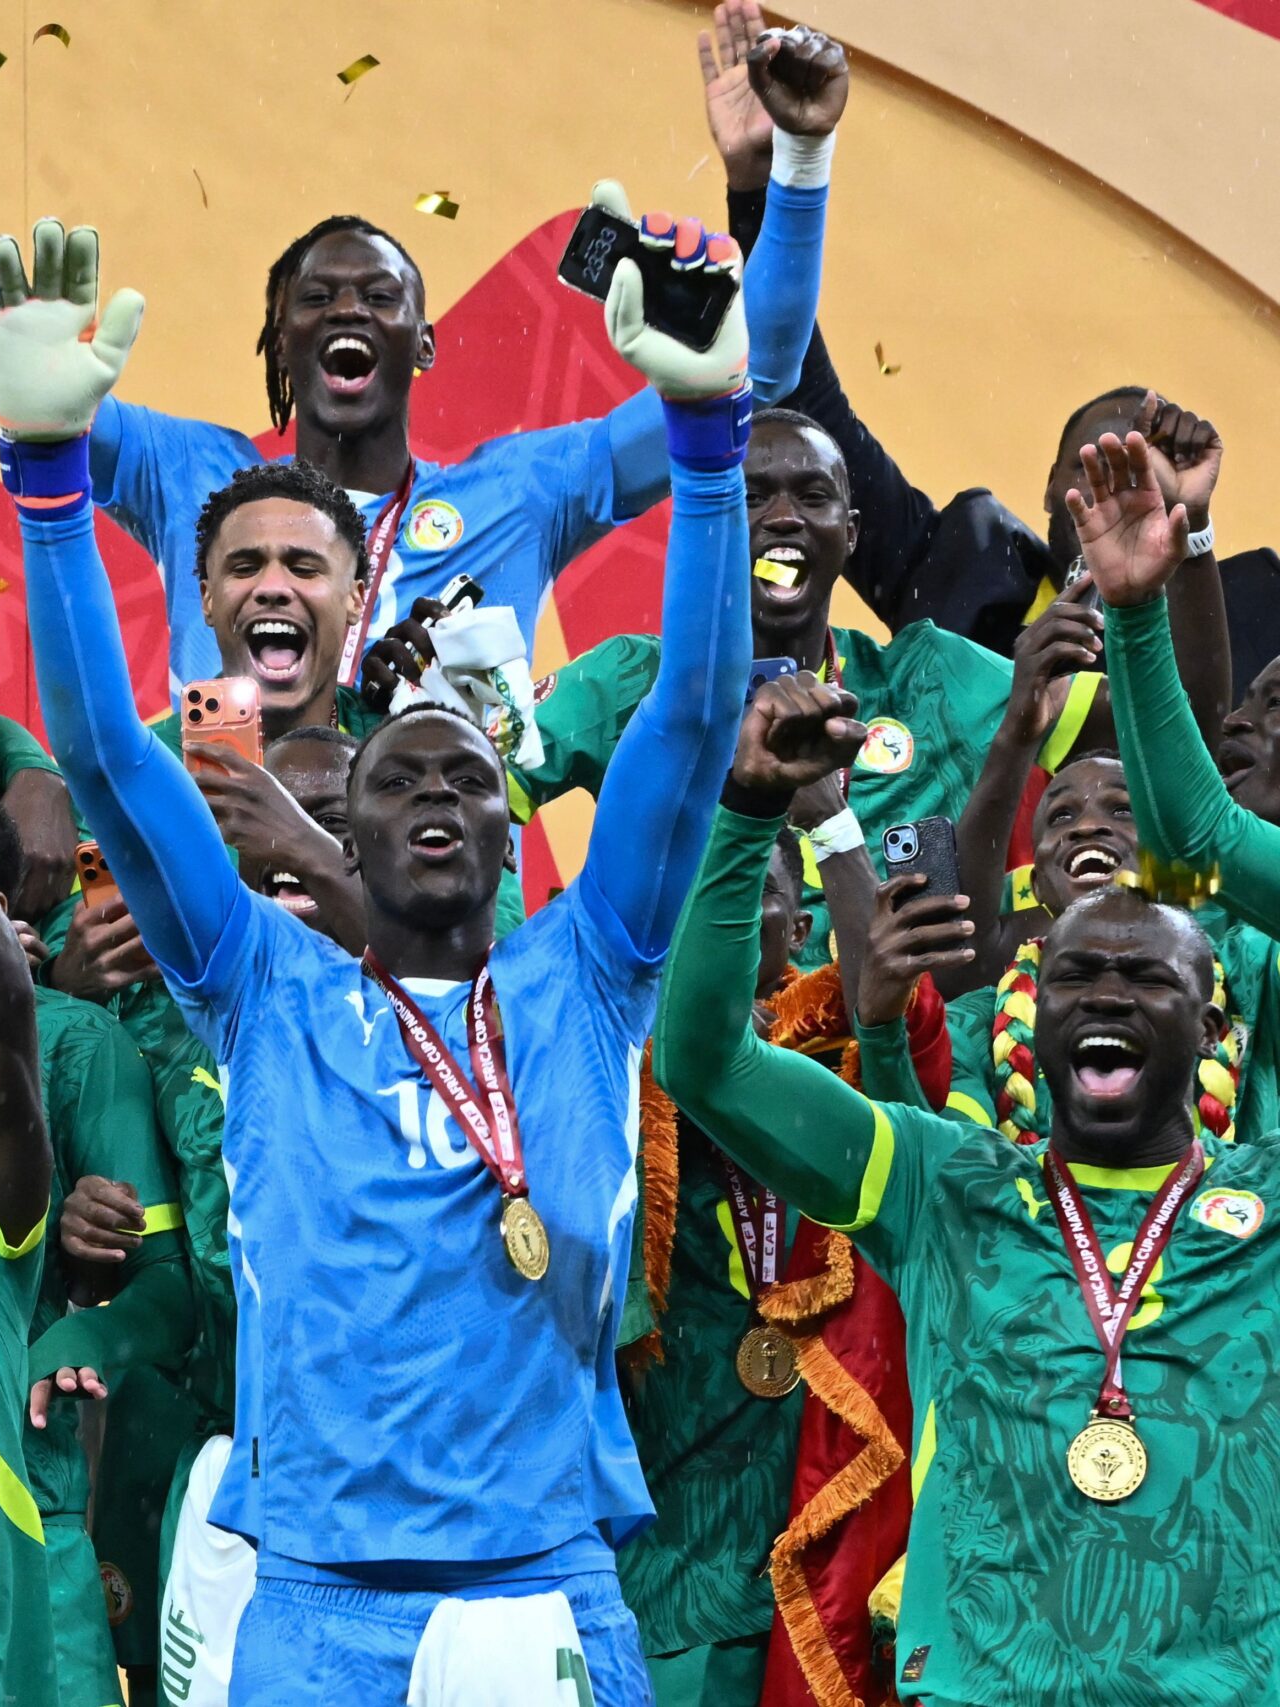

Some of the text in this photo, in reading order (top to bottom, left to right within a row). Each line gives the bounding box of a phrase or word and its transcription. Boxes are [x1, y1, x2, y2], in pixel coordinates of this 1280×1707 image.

[410, 1027, 427, 1042] OF
[422, 1041, 440, 1063] CUP
[436, 1060, 467, 1101] AFRICA
[730, 1175, 749, 1218] AFRICA
[765, 1223, 775, 1256] CAF
[1074, 1233, 1090, 1249] OF
[1120, 1183, 1183, 1299] AFRICA CUP OF NATIONS
[1080, 1248, 1098, 1272] CUP
[1089, 1272, 1113, 1317] AFRICA
